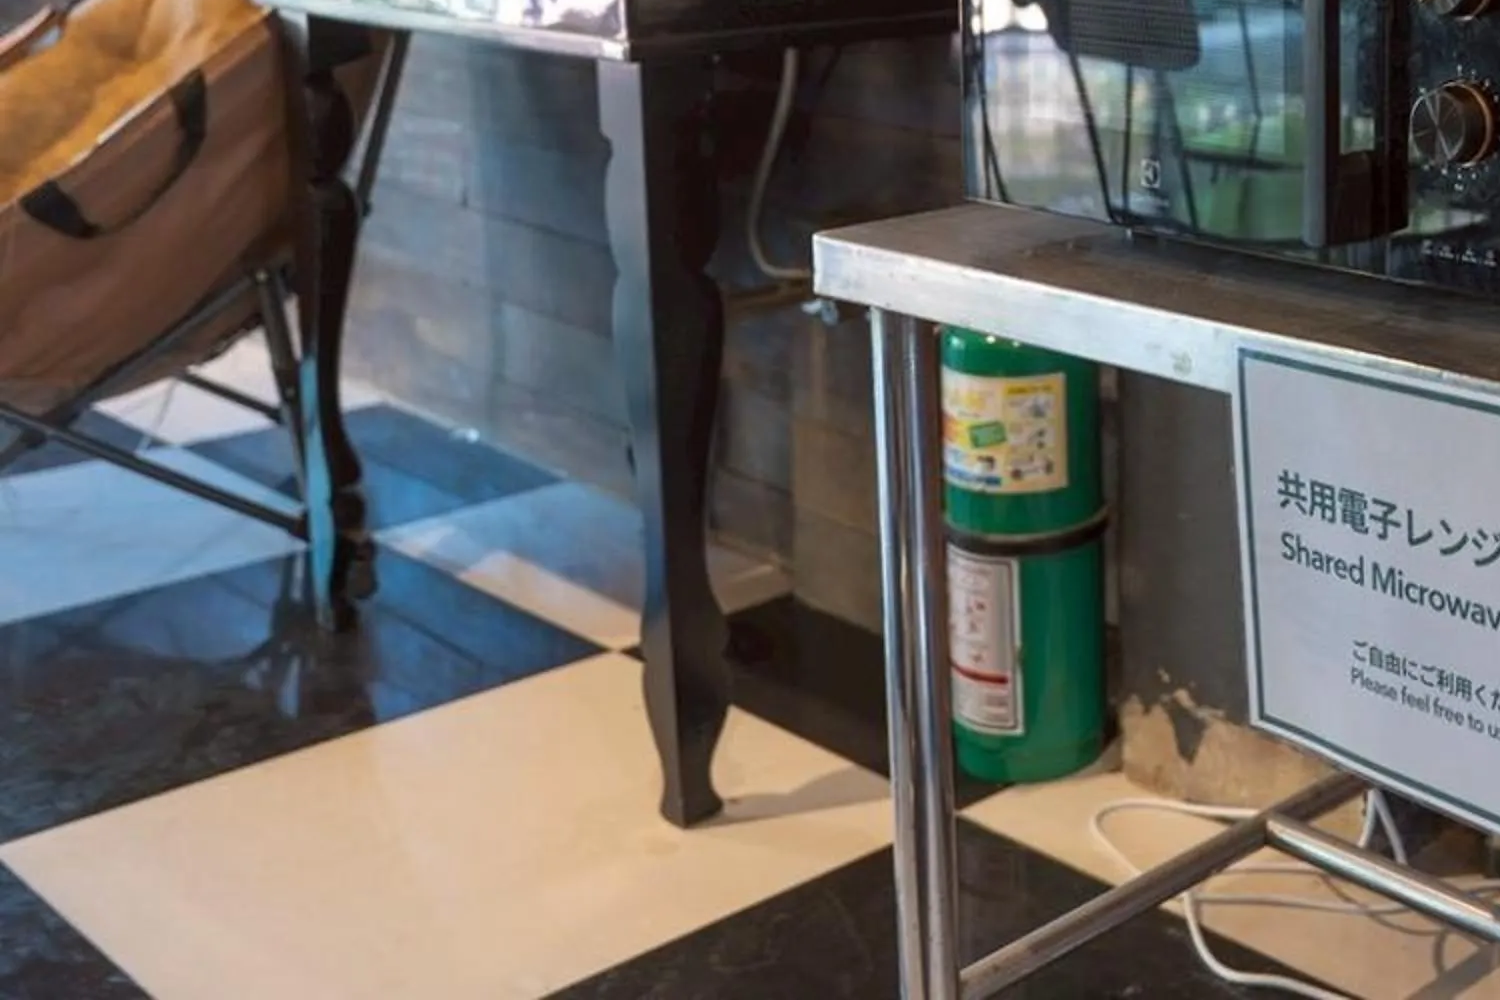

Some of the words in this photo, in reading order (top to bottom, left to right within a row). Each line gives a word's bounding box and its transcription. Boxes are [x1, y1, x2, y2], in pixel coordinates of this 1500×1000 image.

[1280, 530, 1365, 588] Shared
[1350, 665, 1398, 703] Please
[1400, 685, 1431, 714] feel
[1432, 695, 1465, 727] free
[1466, 711, 1485, 735] to
